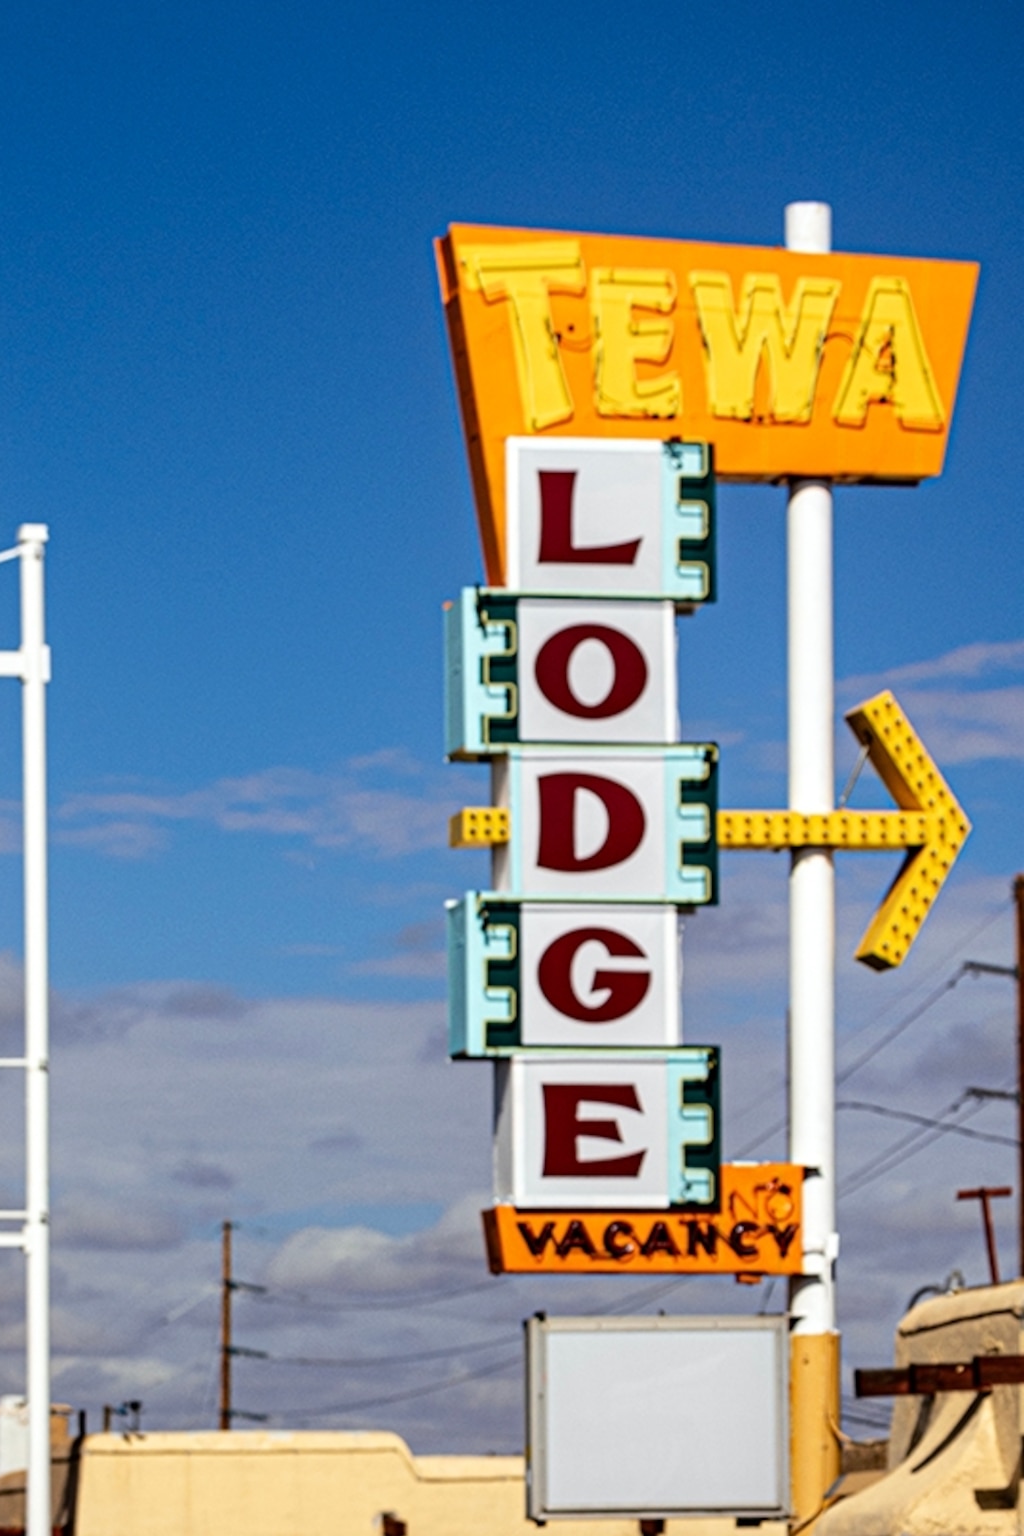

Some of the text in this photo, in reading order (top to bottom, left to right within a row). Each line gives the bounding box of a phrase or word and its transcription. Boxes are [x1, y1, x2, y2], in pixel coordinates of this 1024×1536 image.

[457, 239, 944, 433] TEWA
[533, 469, 651, 1179] LODGE
[516, 1218, 800, 1261] VACANCY
